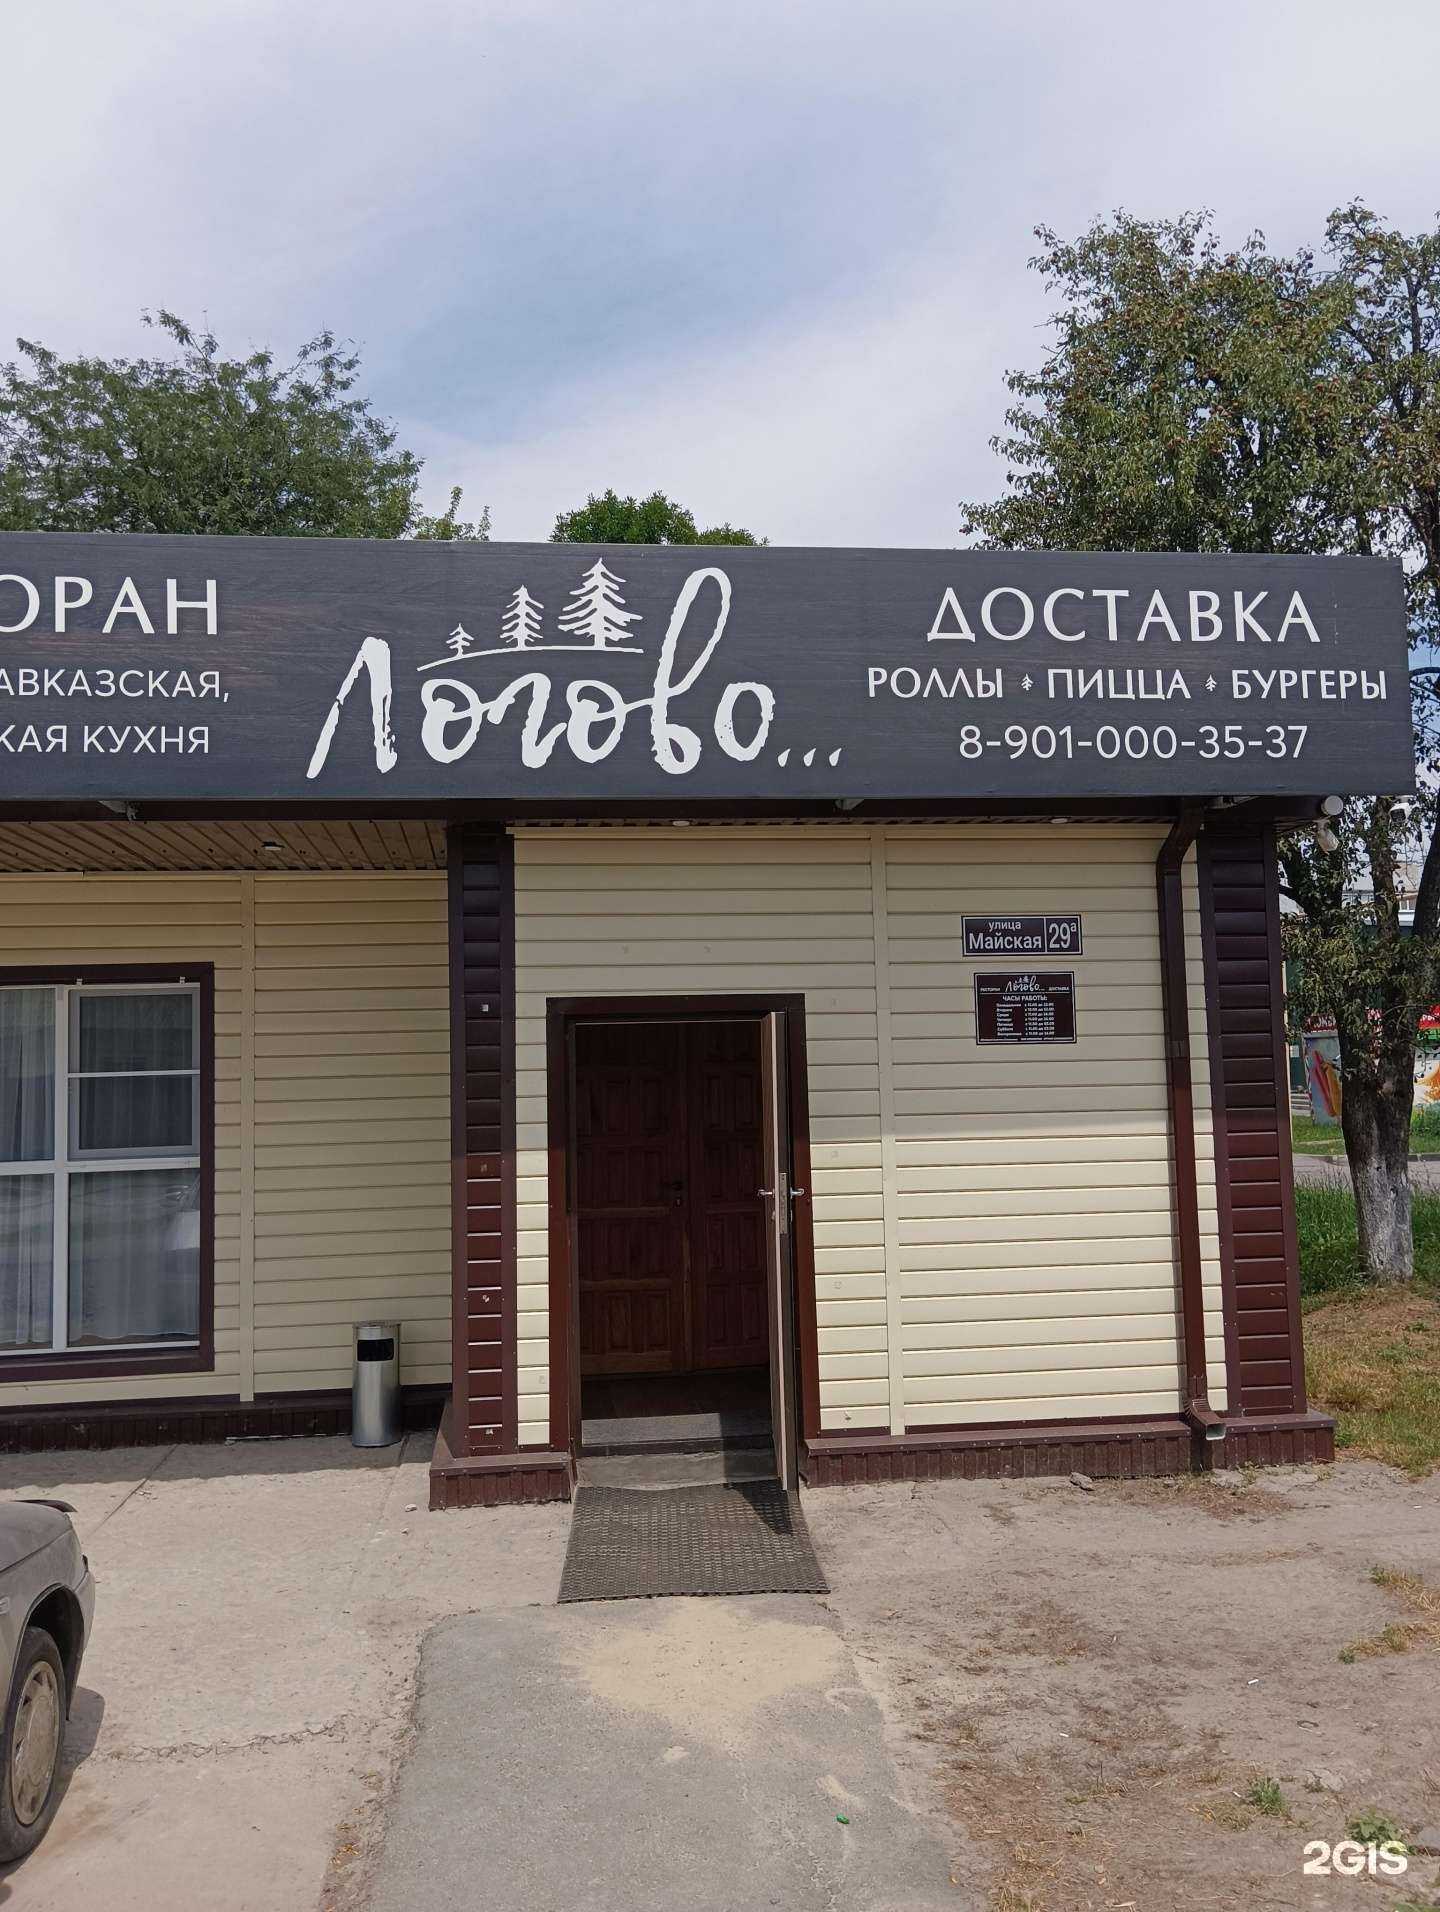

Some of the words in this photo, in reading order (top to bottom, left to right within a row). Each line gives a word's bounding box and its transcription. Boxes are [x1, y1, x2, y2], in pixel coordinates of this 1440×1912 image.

[0, 574, 218, 635] ОРАН
[926, 586, 1321, 643] ДОСТАВКА
[0, 668, 230, 703] АВКАЗСКАЯ,
[867, 667, 1003, 699] РОЛЛЫ
[1047, 668, 1192, 700] ПИЦЦА
[1231, 669, 1387, 700] БУРГЕРЫ
[83, 725, 209, 754] КУХНЯ
[959, 725, 1308, 760] 8-901-000-35-37
[969, 932, 1042, 950] Майская
[988, 921, 1021, 932] улица
